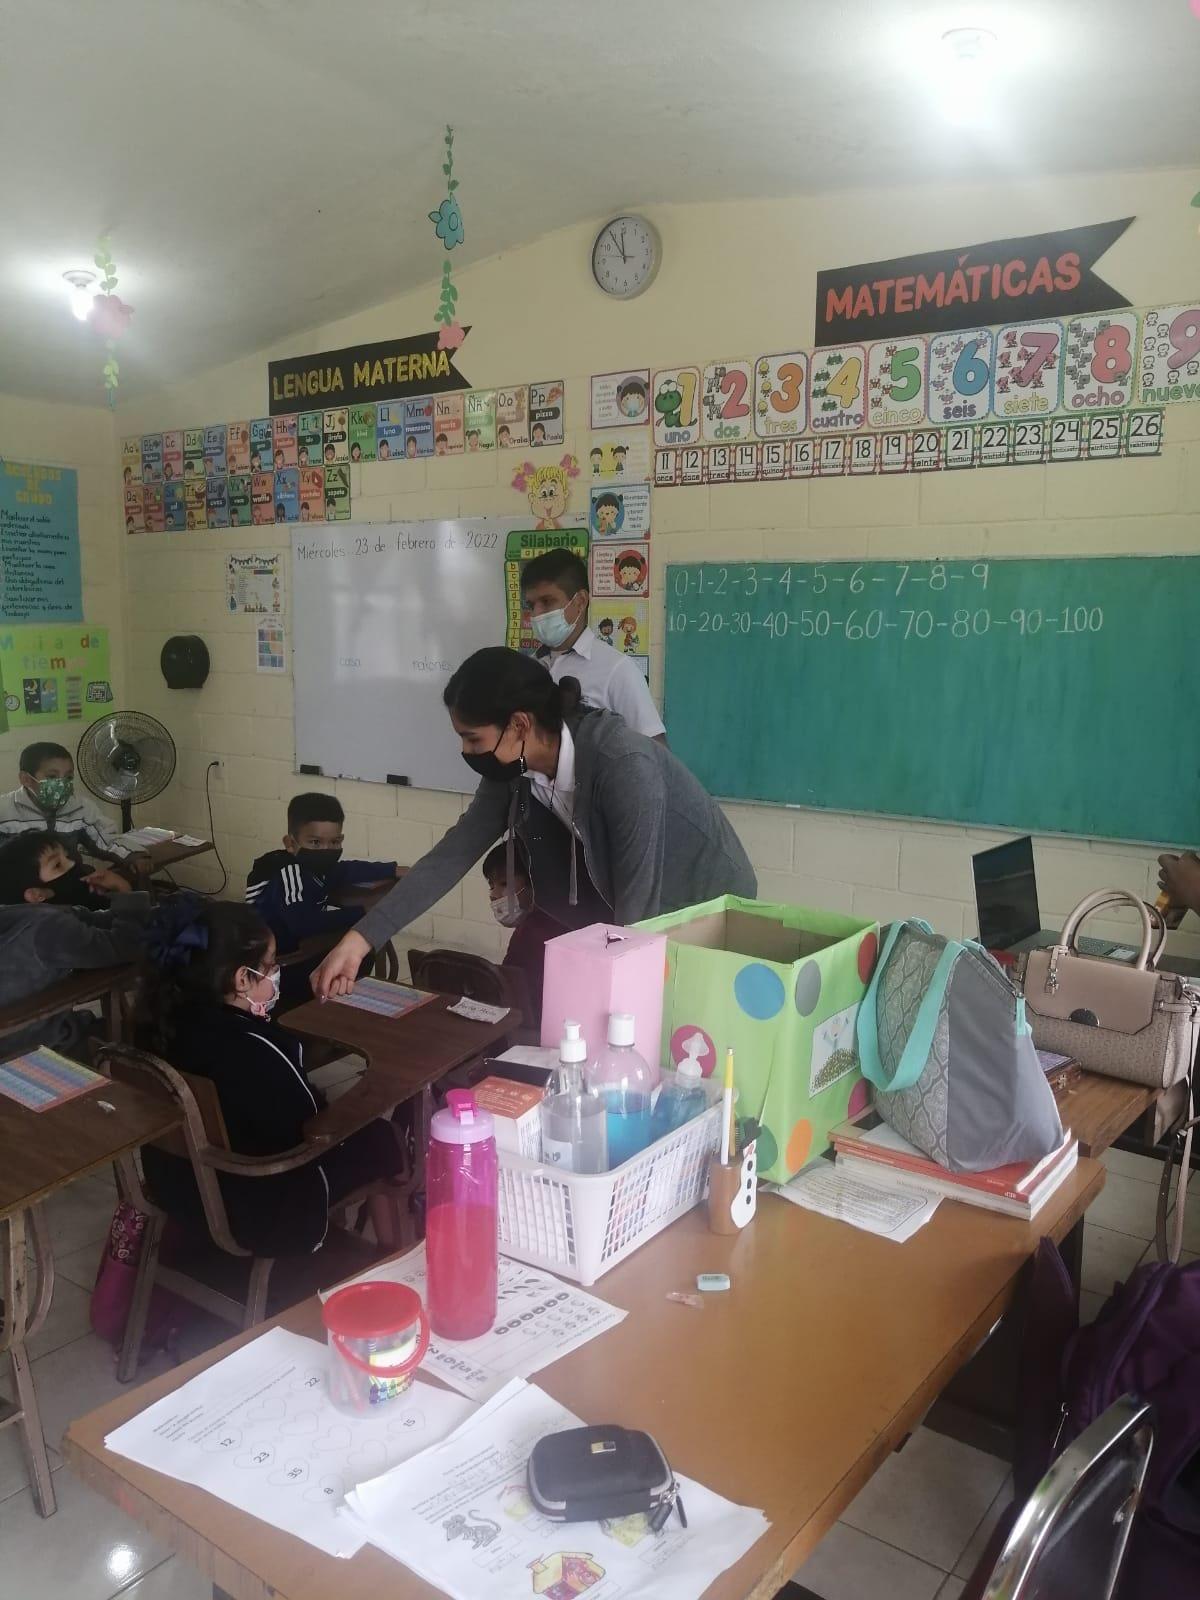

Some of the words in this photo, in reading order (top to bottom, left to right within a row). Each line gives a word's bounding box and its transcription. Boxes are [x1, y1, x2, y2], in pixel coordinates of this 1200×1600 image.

[825, 252, 1082, 323] MATEMÁTICAS
[1166, 308, 1200, 370] 9
[1020, 331, 1060, 388] 7
[1090, 324, 1133, 384] 8
[272, 366, 345, 401] LENGUA
[353, 349, 451, 389] MATERNA
[888, 346, 922, 402] 5
[952, 338, 990, 397] 6
[769, 362, 804, 414] 3
[826, 356, 862, 409] 4
[498, 392, 513, 407] Oo
[531, 388, 546, 407] Pp
[677, 372, 698, 427] 1
[720, 369, 750, 420] 2
[1003, 391, 1049, 415] siete
[1071, 385, 1125, 408] ocho
[406, 401, 425, 418] Mm
[436, 400, 450, 416] Nn
[871, 407, 922, 425] cinco
[943, 400, 977, 420] seis
[276, 419, 288, 434] Hh
[325, 414, 335, 430] Jj
[763, 416, 798, 434] tres
[812, 410, 864, 429] cuatro
[1092, 417, 1119, 440] 25
[1130, 414, 1160, 437] 26
[664, 428, 691, 444] uno
[713, 421, 741, 439] dos
[982, 426, 1007, 448] 22
[1016, 424, 1041, 446] 23
[1054, 420, 1080, 443] 24
[825, 440, 841, 460] 17
[855, 439, 871, 459] 18
[885, 435, 901, 455] 19
[913, 432, 938, 454] 20
[951, 430, 969, 451] 21
[661, 452, 671, 470] 11
[685, 450, 699, 469] 12
[712, 448, 727, 467] 13
[739, 446, 754, 465] 14
[766, 445, 780, 464] 15
[794, 443, 810, 463] 16
[326, 468, 338, 483] Zz
[354, 537, 369, 556] 23
[374, 535, 386, 553] de
[397, 531, 437, 552] febrero
[464, 531, 499, 550] 2022
[520, 532, 579, 548] Silabario
